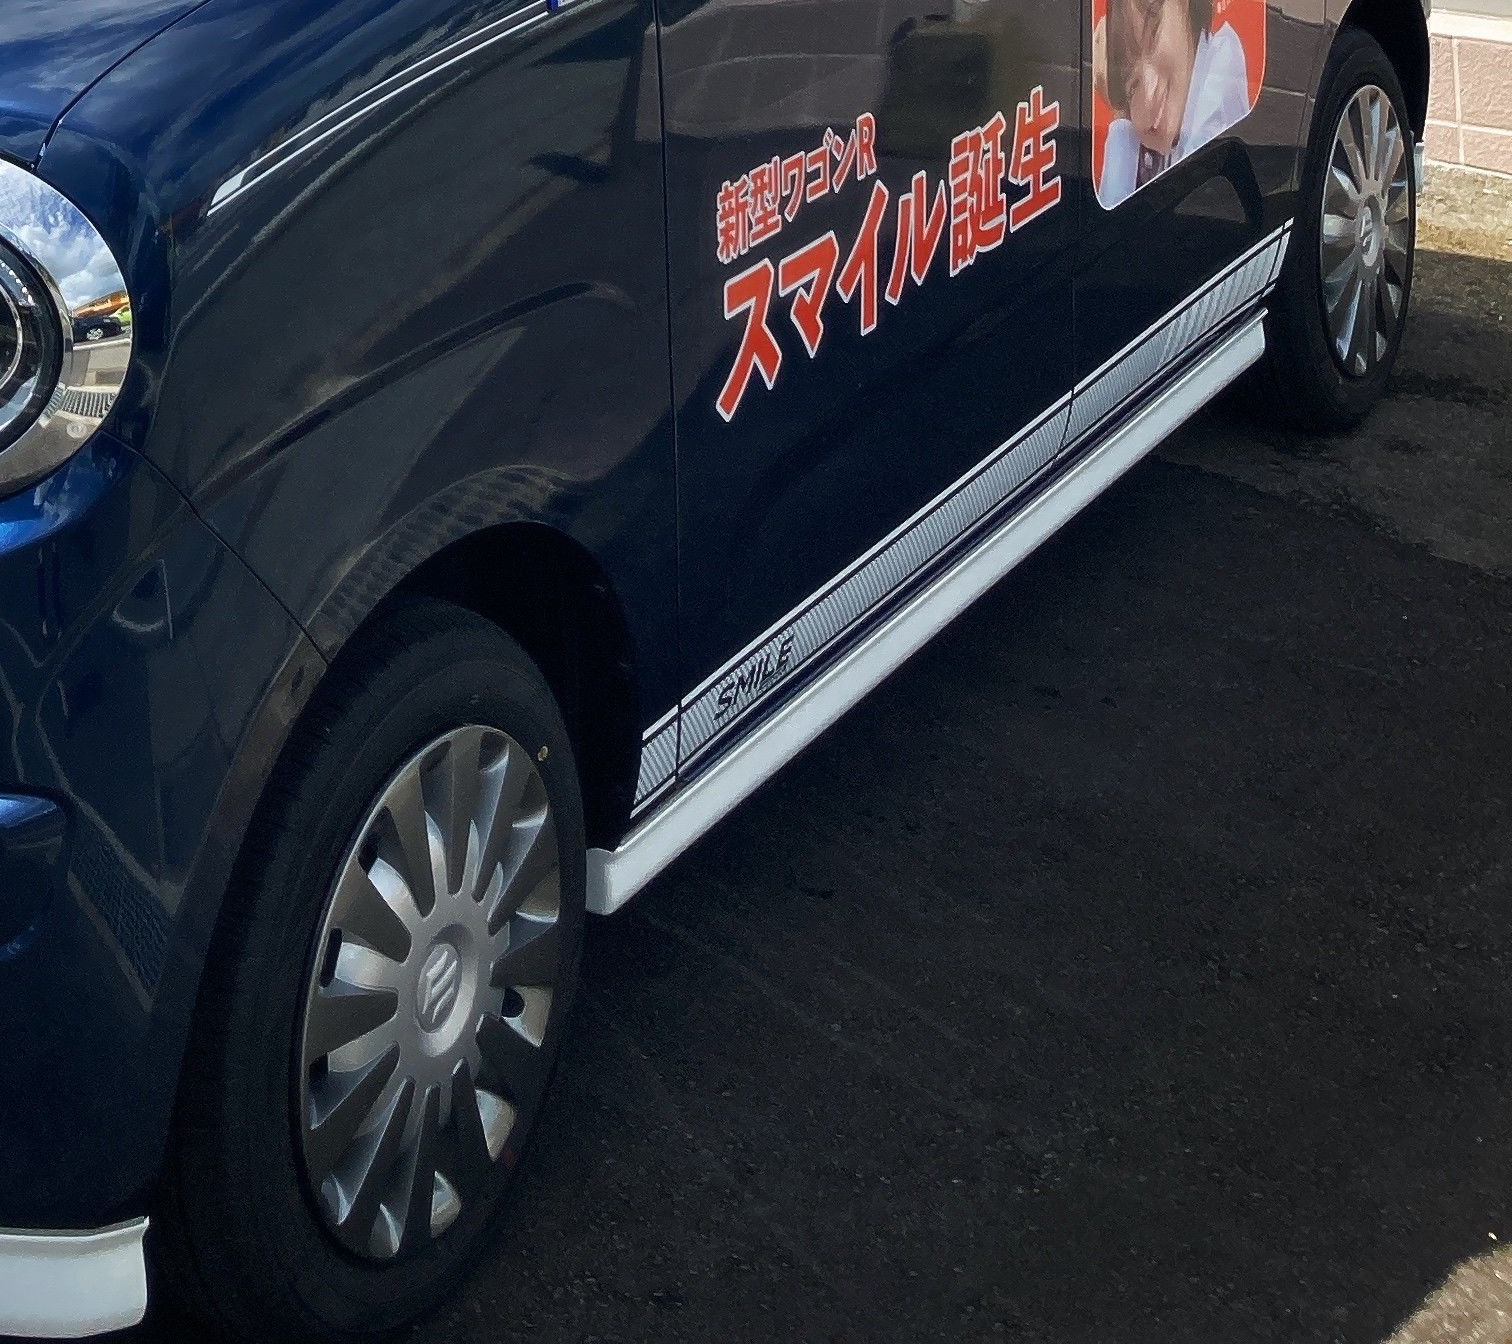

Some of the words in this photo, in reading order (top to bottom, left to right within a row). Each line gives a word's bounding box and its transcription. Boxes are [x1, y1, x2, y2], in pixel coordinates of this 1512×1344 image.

[716, 113, 877, 264] 新型ワゴンR
[716, 85, 1062, 422] スマイル誕生
[713, 636, 796, 721] SMILE
